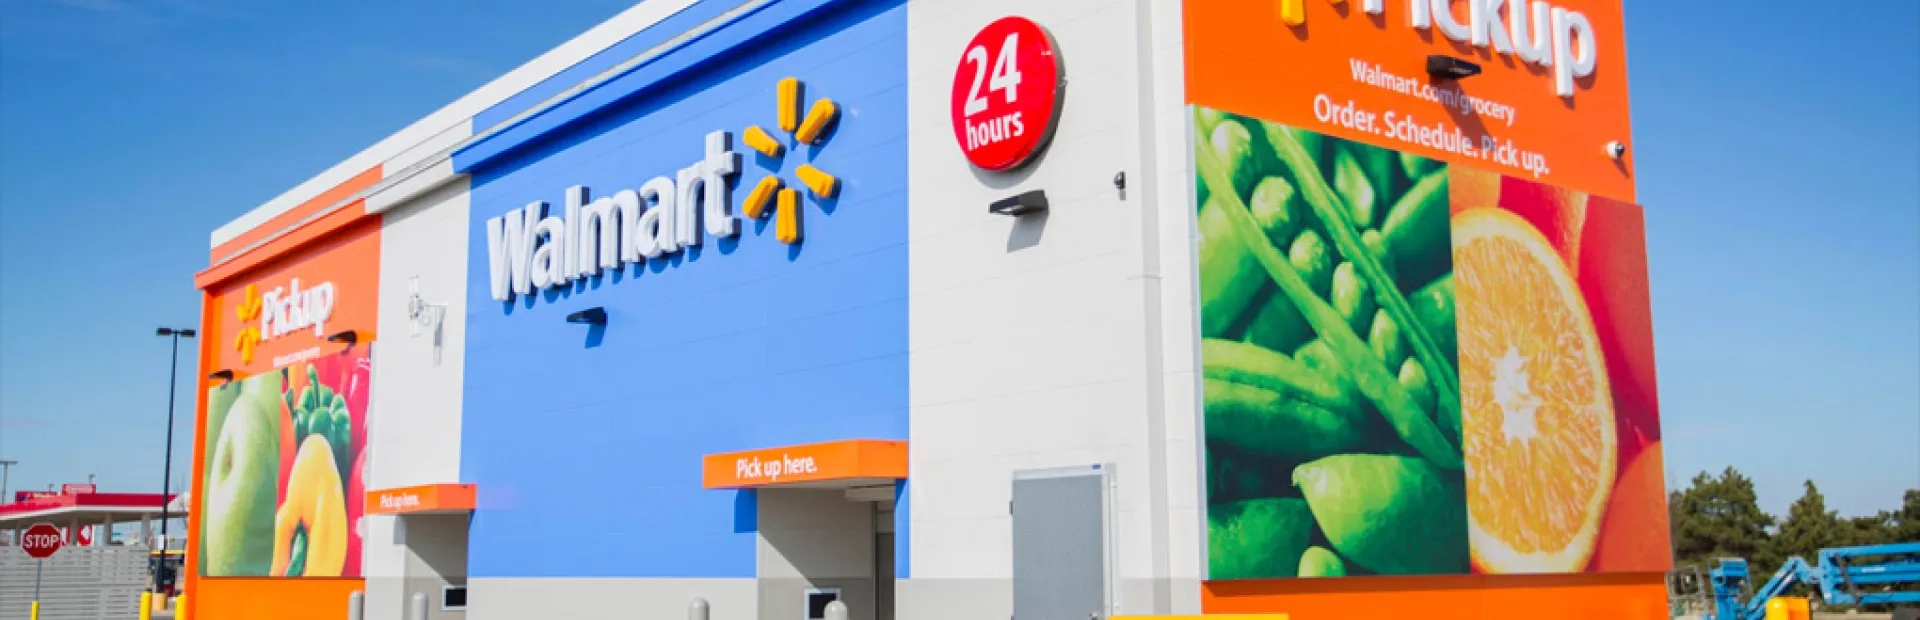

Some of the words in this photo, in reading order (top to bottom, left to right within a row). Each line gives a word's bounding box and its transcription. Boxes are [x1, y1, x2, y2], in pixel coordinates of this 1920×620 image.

[964, 32, 1022, 117] 24
[1363, 0, 1597, 97] ckup
[1350, 57, 1515, 126] Walmart.com/grocery
[965, 111, 1024, 151] hours
[1313, 93, 1381, 135] Order.
[1384, 111, 1478, 158] Schedule.
[1481, 134, 1519, 168] Pick
[1521, 150, 1550, 178] up.
[486, 129, 741, 301] Walmart
[261, 278, 335, 340] Pickup
[736, 455, 762, 479] Pick
[764, 460, 782, 481] up
[783, 453, 818, 476] here.
[25, 534, 60, 549] STOP
